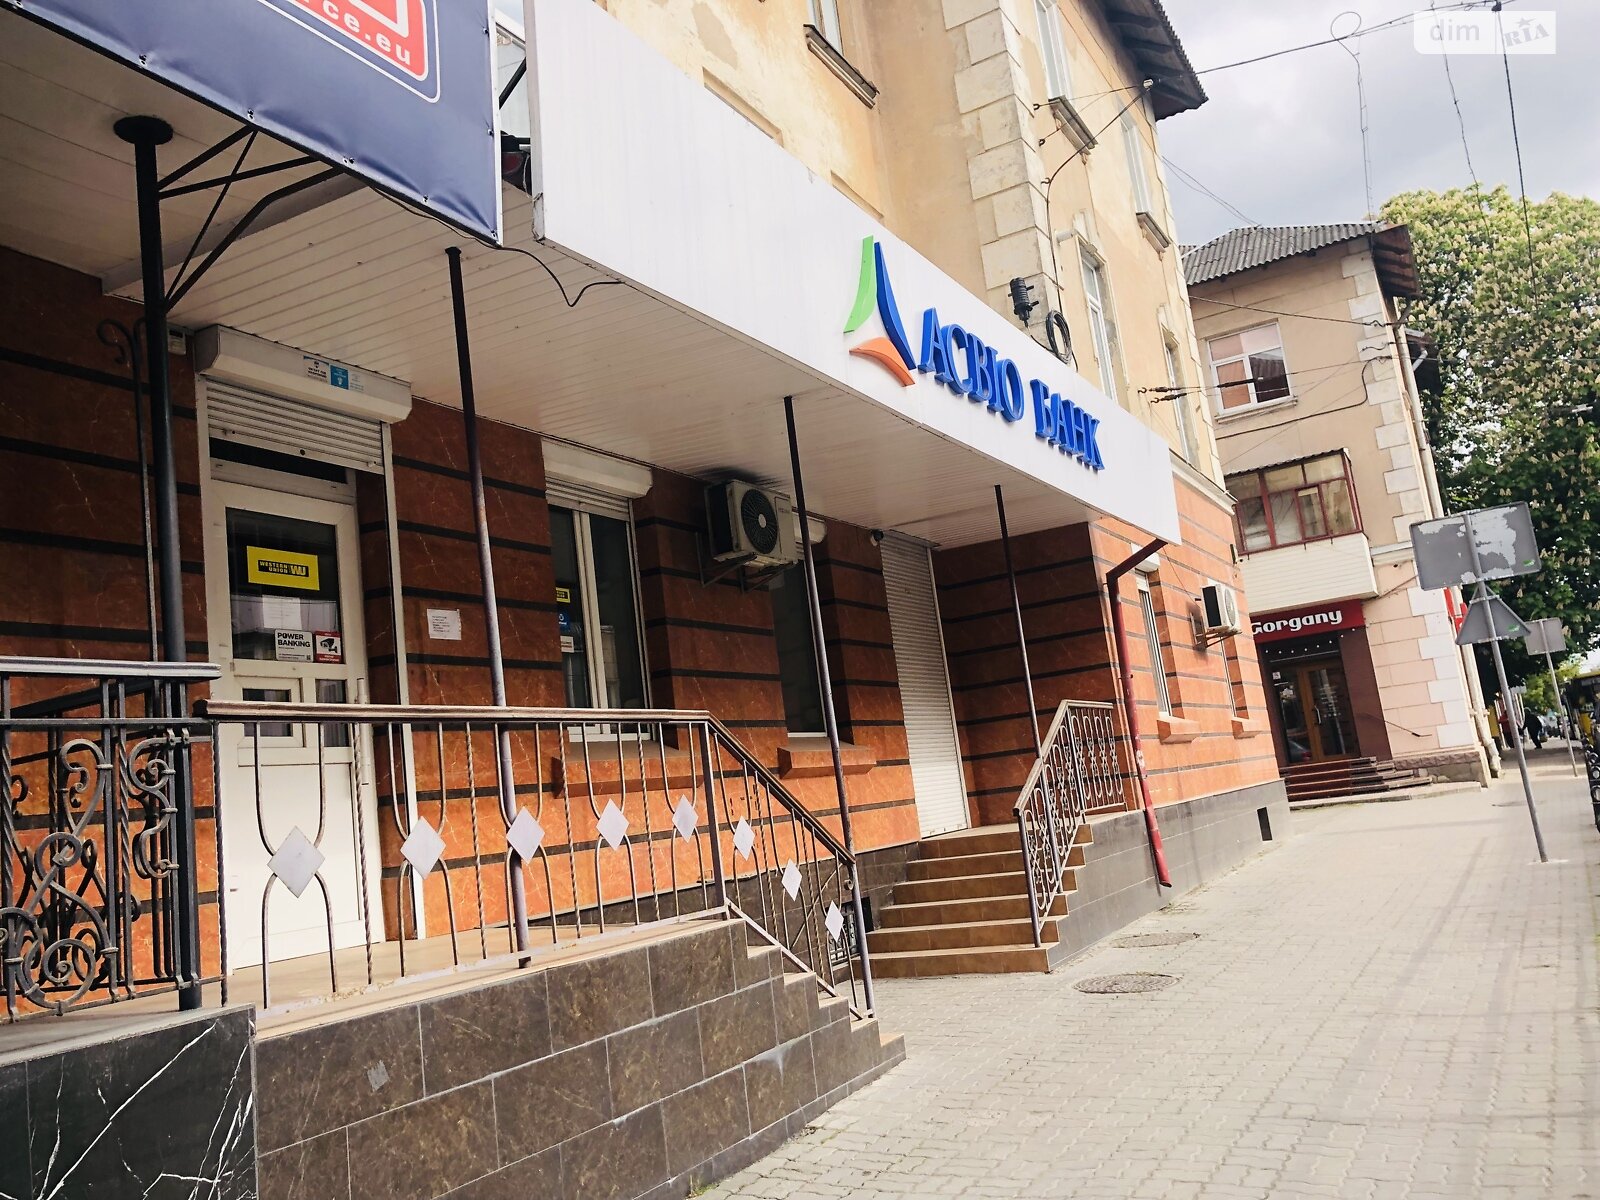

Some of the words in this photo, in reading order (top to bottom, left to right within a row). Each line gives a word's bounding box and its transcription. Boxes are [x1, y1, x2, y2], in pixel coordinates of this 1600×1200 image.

[300, 0, 411, 65] ce.eu
[1030, 379, 1105, 471] БАНК
[277, 632, 304, 640] POWER
[277, 639, 311, 648] BANKING
